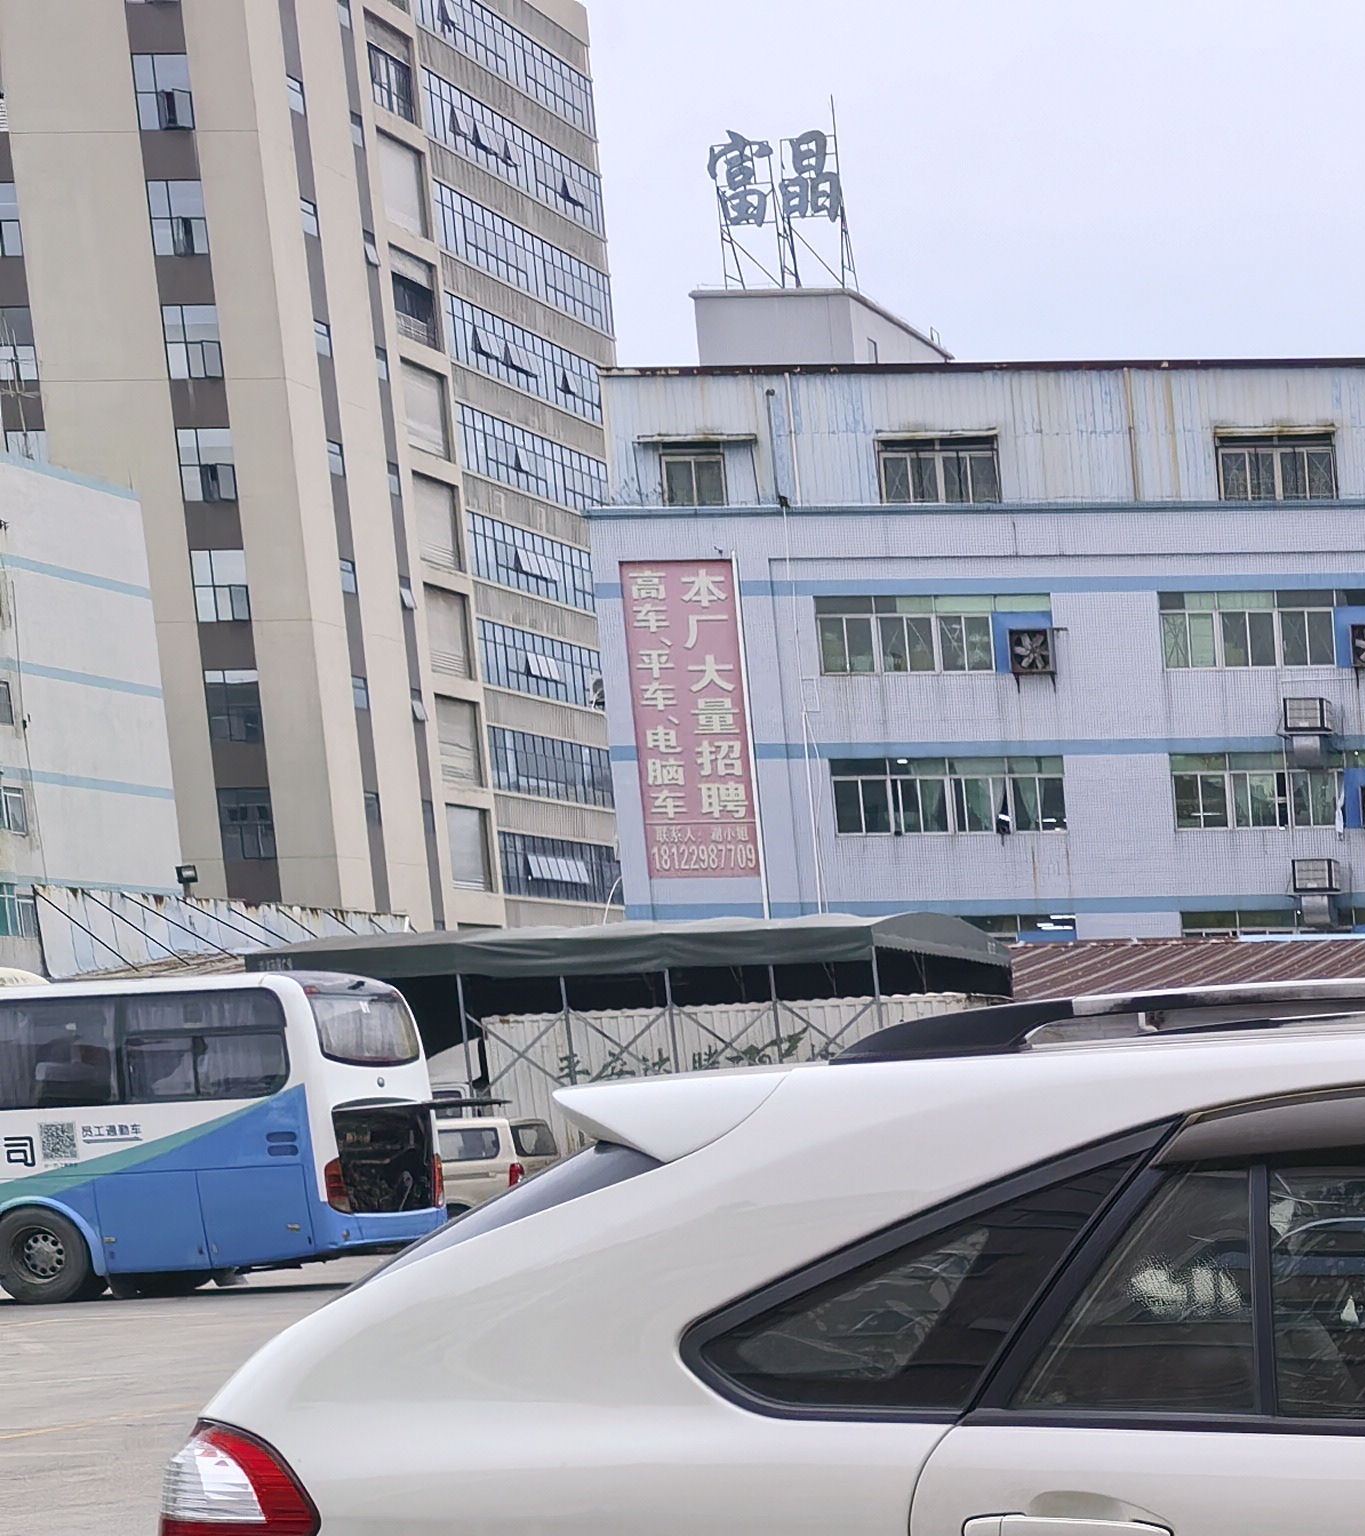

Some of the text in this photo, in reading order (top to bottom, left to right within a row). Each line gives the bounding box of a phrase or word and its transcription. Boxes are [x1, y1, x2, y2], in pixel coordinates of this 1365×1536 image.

[707, 129, 841, 227] 富晶
[628, 569, 687, 819] 高车、平车、电脑车
[681, 567, 747, 819] 本厂大量招聘
[651, 844, 757, 871] 18122987709
[4, 1136, 36, 1167] 司
